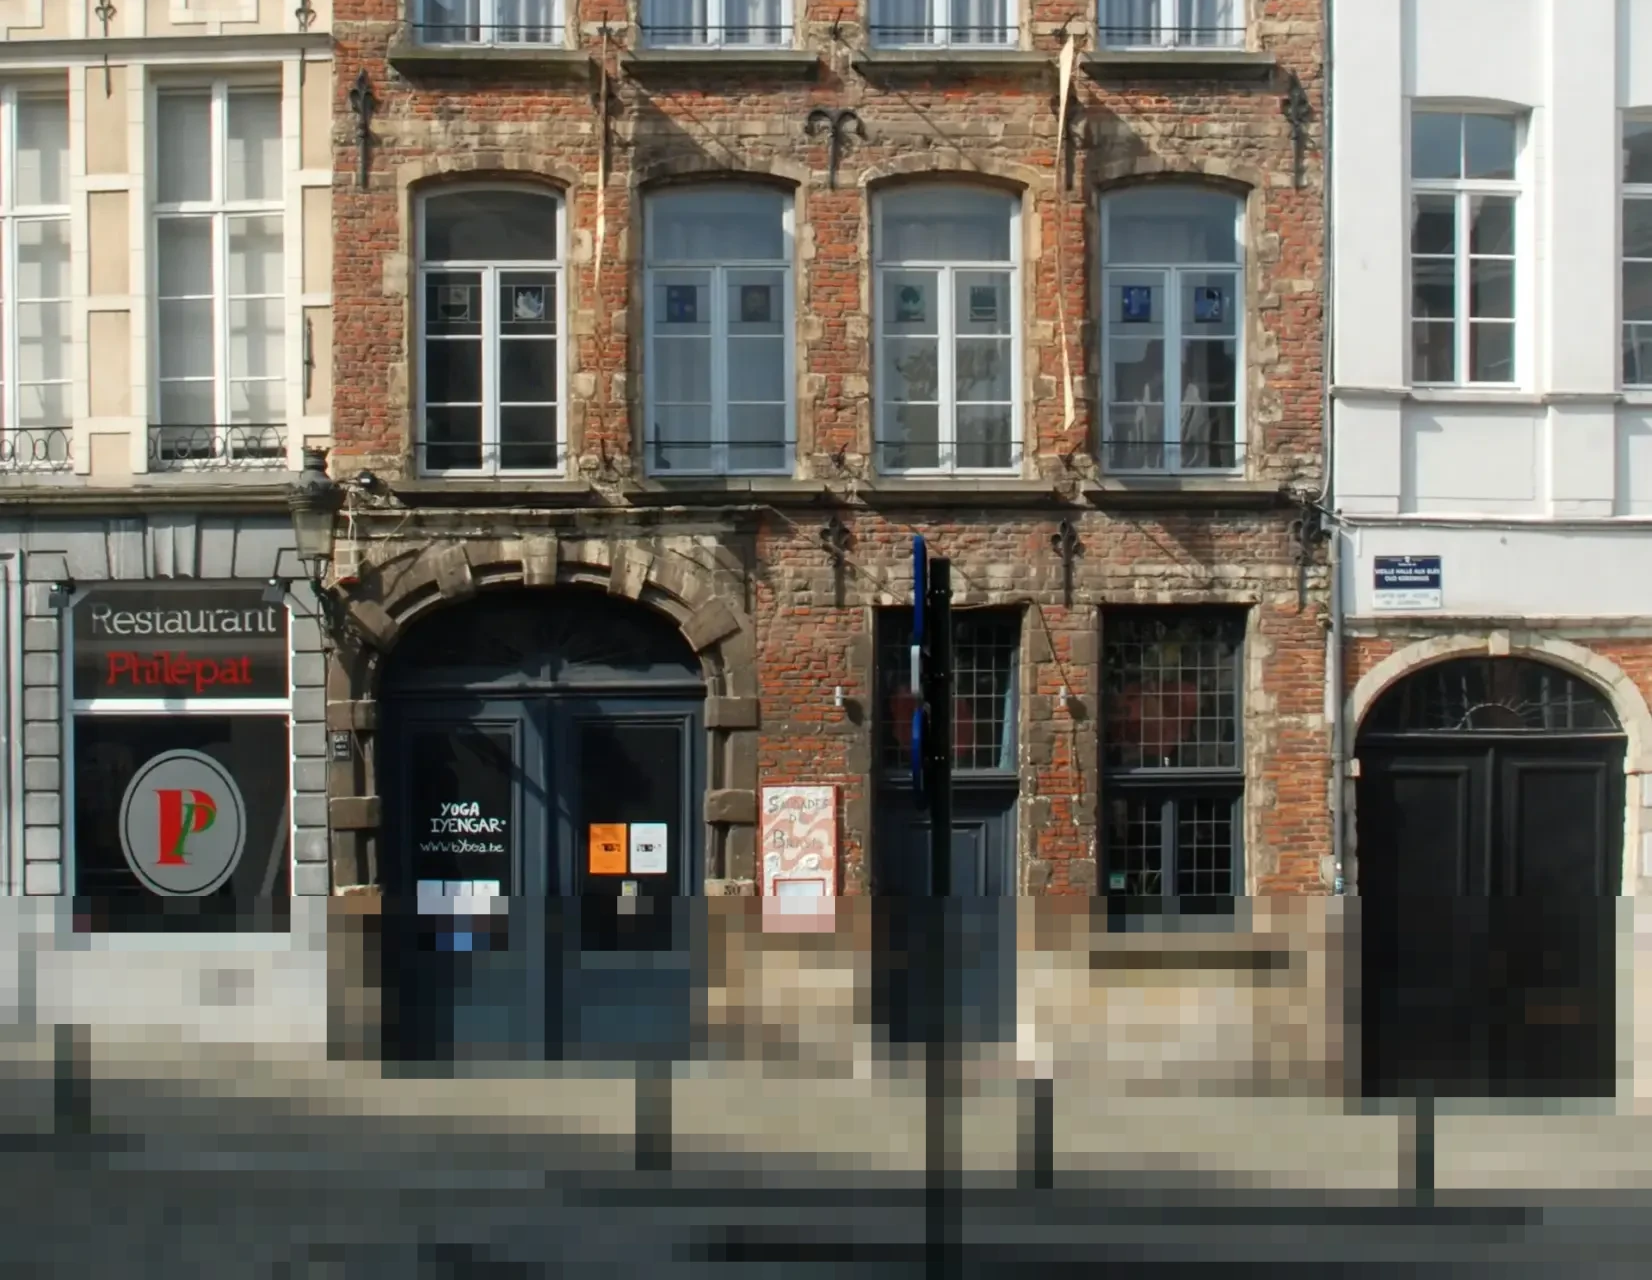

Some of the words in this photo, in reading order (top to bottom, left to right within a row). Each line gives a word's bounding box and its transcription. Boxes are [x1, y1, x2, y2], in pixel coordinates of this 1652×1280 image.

[91, 603, 276, 634] Restaurant
[106, 650, 253, 694] Philépat
[441, 801, 480, 817] YOGA
